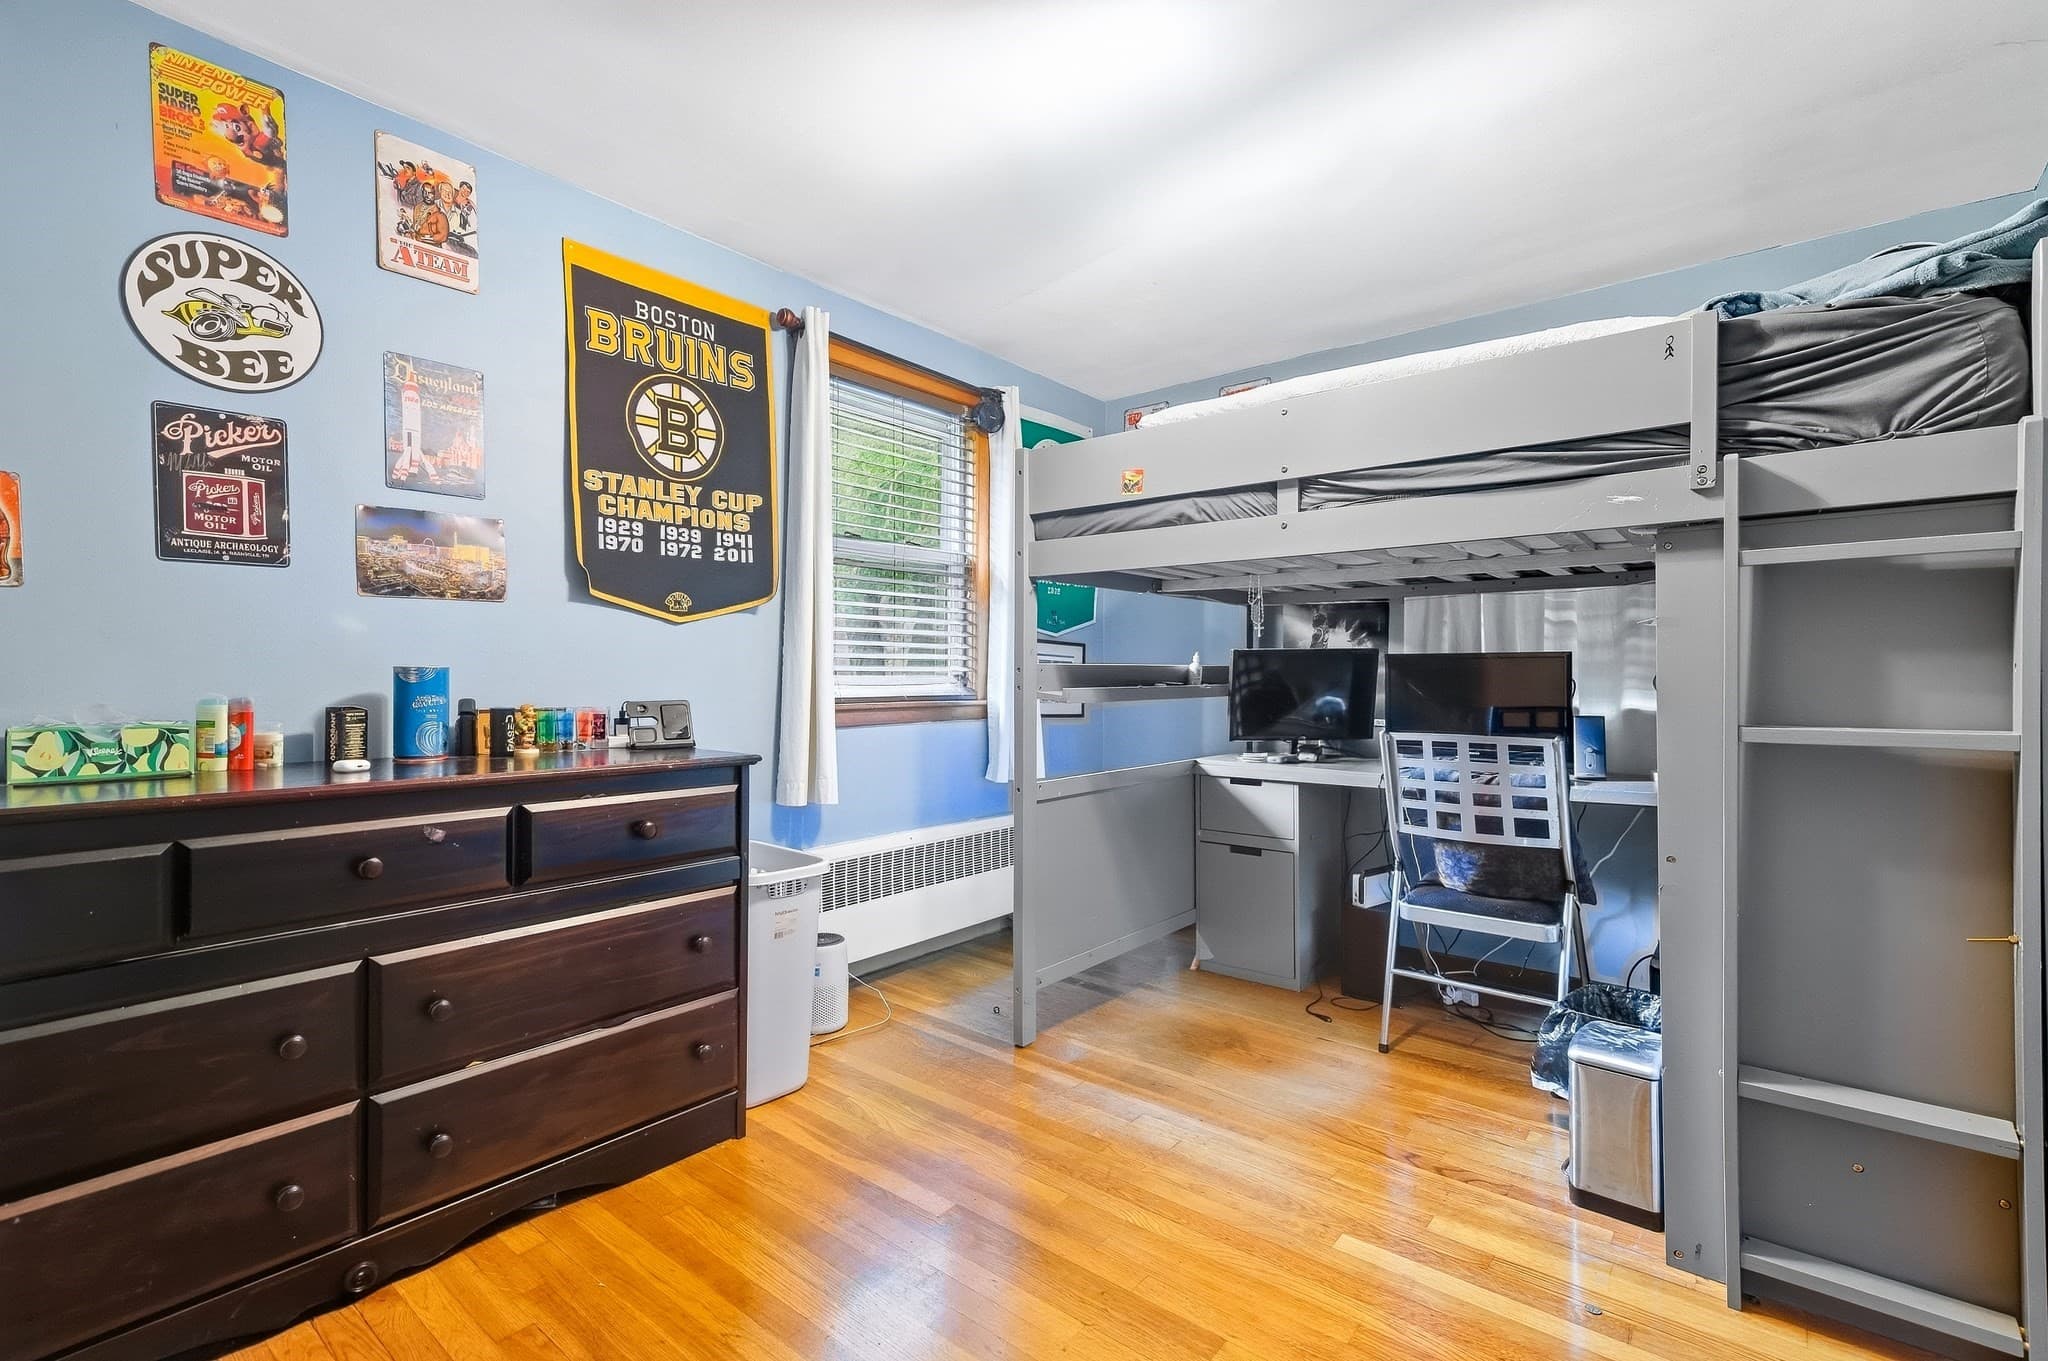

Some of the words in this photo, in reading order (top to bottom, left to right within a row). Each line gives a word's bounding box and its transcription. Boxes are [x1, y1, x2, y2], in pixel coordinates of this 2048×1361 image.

[165, 52, 247, 88] NINTENDO
[158, 82, 199, 106] SUPER
[158, 94, 201, 117] MARIO
[198, 75, 271, 110] POWER
[199, 117, 206, 131] 3
[391, 246, 416, 267] A
[414, 249, 468, 277] TEAM
[137, 240, 309, 318] SUPER
[635, 300, 715, 342] BOSTON
[172, 334, 295, 384] BEE
[584, 305, 755, 392] BRUINS
[161, 413, 282, 459] Picker
[655, 394, 698, 458] B
[241, 454, 281, 466] MOTOR
[252, 463, 273, 472] OIL
[187, 479, 241, 499] Picker
[583, 469, 703, 505] STANLEY
[711, 490, 763, 512] CUP
[194, 512, 237, 524] MOTOR
[204, 521, 227, 530] OIL
[598, 494, 750, 532] CHAMPIONS
[170, 537, 212, 549] ANTIQUE
[214, 541, 279, 554] ARCHAEOLOGY
[598, 516, 644, 537] 1929
[660, 524, 702, 543] 1939
[716, 532, 753, 549] 1941
[598, 533, 644, 553] 1970
[660, 541, 703, 559] 1972
[713, 547, 754, 563] 2011
